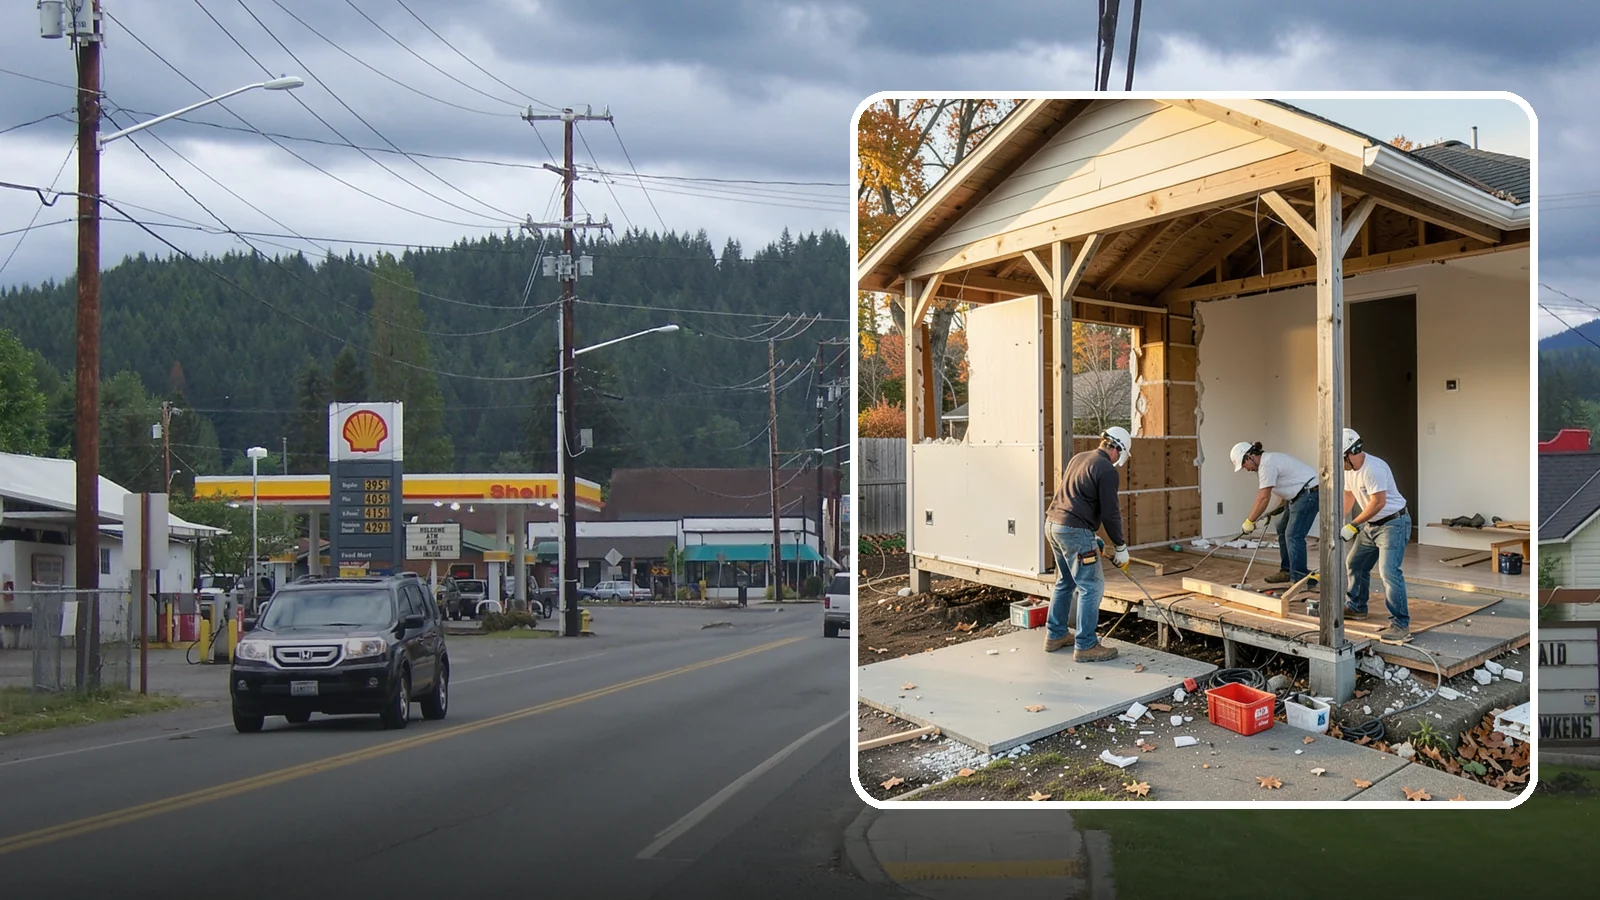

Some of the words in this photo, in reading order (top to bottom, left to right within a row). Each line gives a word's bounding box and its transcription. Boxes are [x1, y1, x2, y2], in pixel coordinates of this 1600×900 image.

[366, 480, 384, 490] 395
[490, 484, 547, 499] Shell
[366, 494, 384, 504] 405
[366, 508, 384, 518] 415
[366, 522, 384, 532] 429
